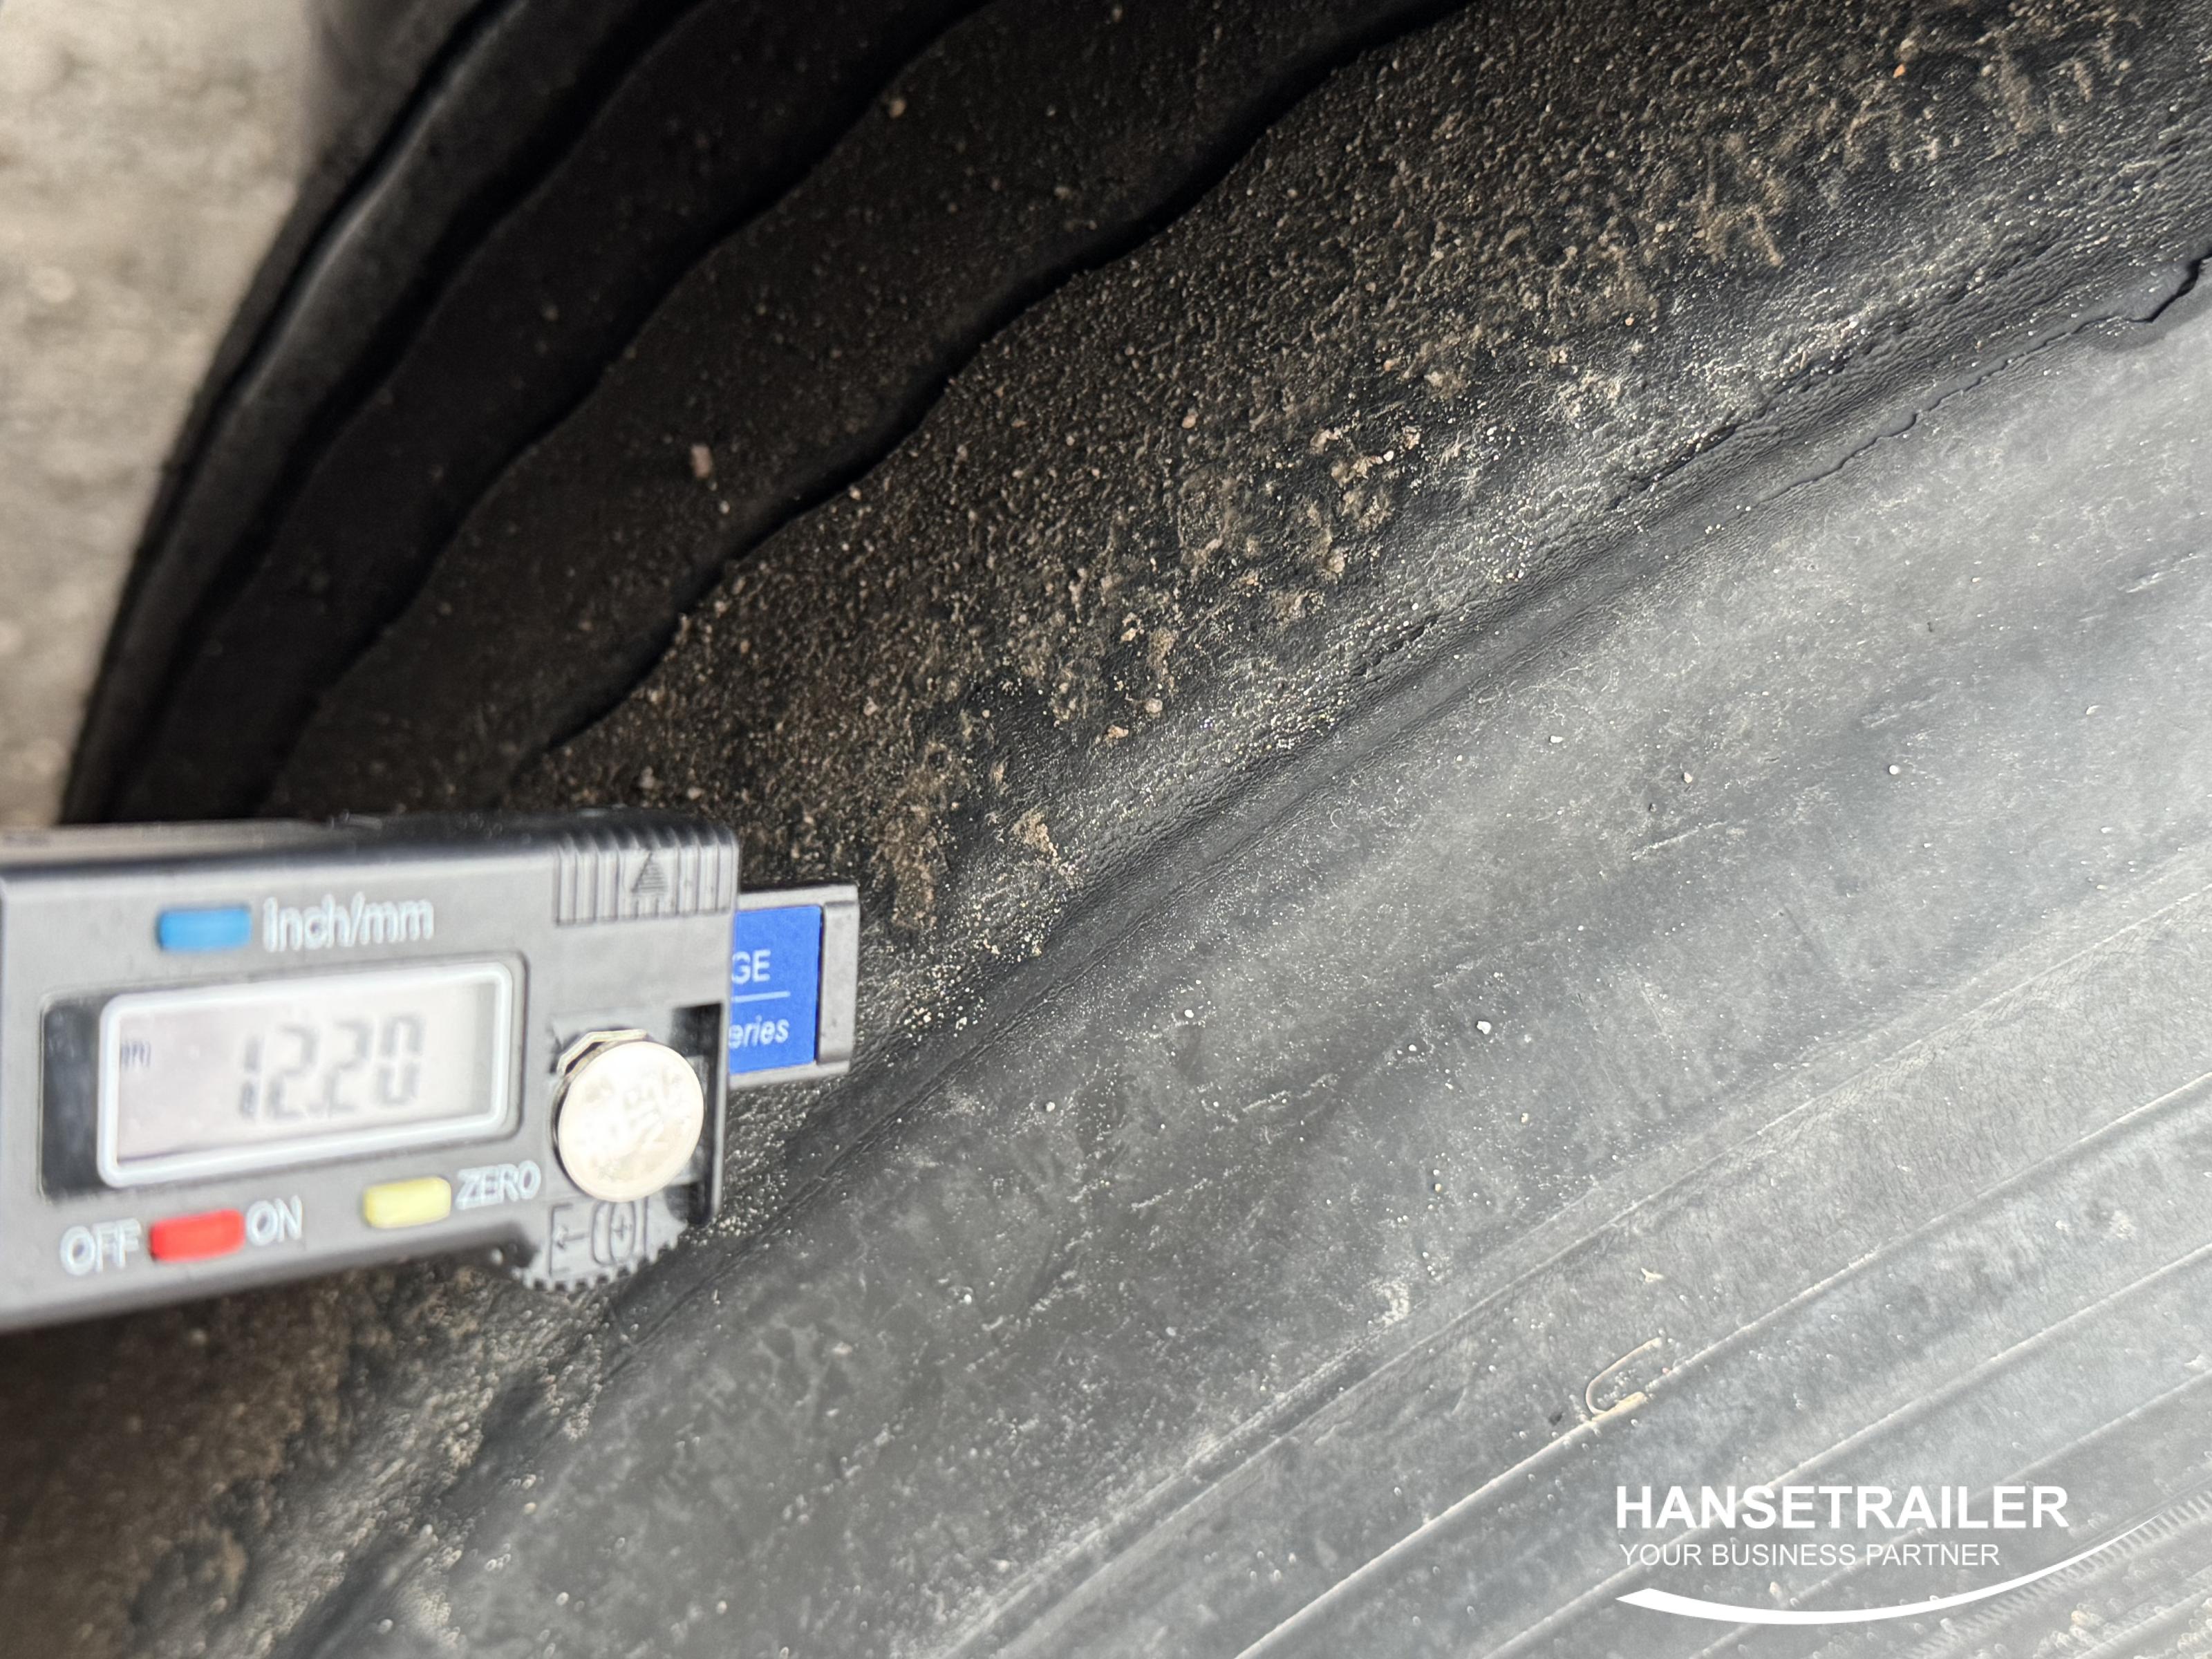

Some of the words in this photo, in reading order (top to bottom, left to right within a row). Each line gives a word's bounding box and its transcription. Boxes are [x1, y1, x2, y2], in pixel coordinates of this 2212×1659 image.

[456, 1160, 542, 1211] ZERO
[247, 1195, 303, 1246] ON
[60, 1219, 142, 1276] OFF
